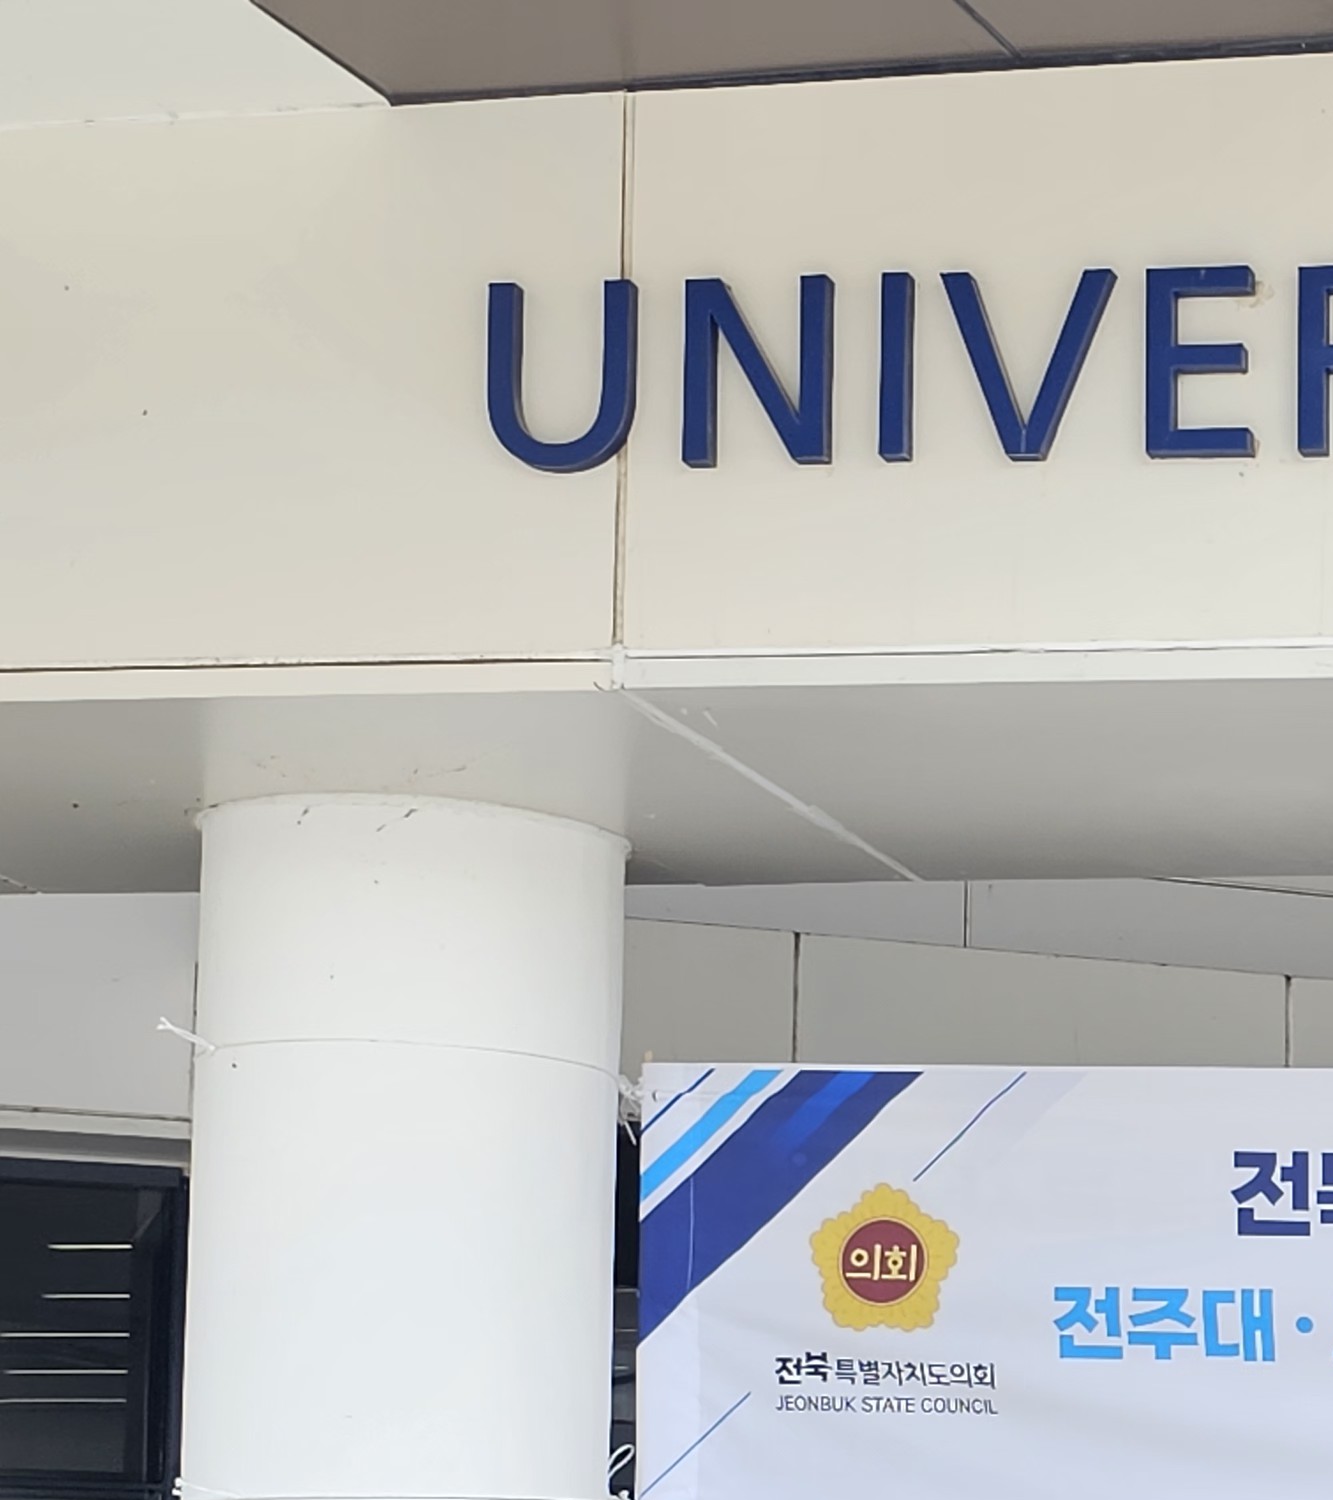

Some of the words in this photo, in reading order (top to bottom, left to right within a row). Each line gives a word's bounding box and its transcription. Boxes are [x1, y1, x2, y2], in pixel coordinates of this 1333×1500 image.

[845, 1244, 917, 1282] 의회
[775, 1395, 857, 1413] JEONBUK
[861, 1396, 916, 1413] STATE
[920, 1397, 999, 1415] COUNCIL
